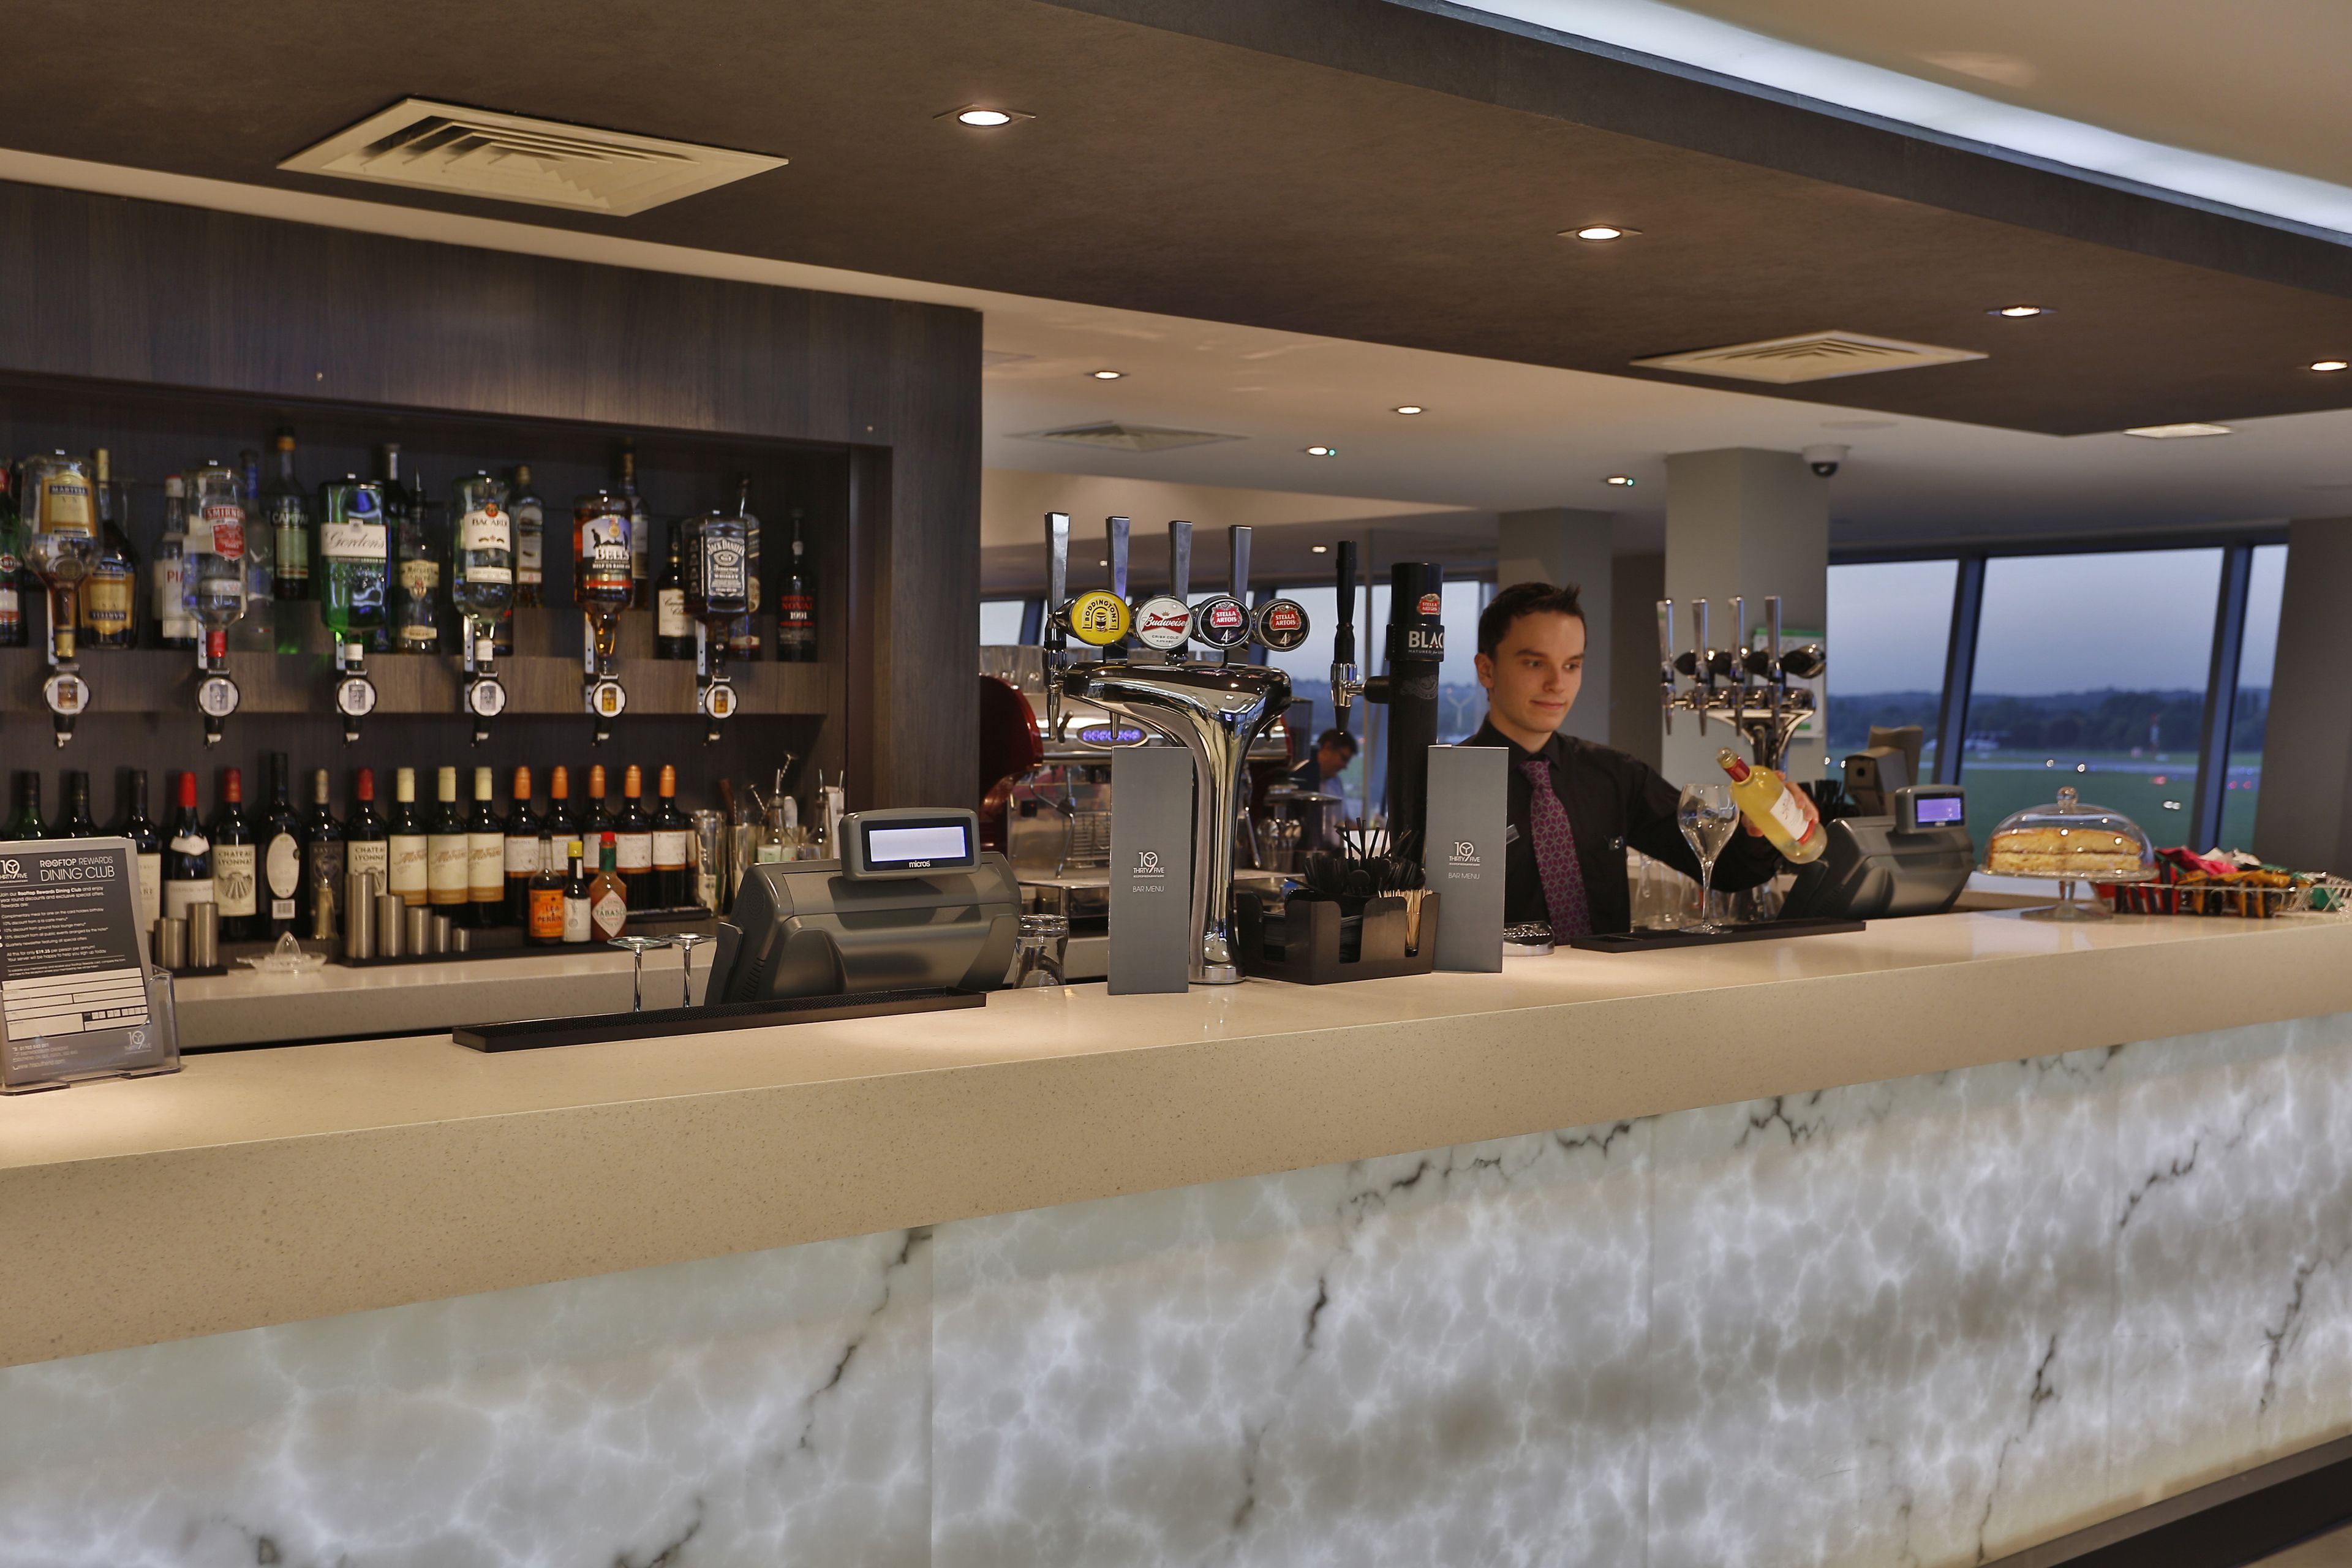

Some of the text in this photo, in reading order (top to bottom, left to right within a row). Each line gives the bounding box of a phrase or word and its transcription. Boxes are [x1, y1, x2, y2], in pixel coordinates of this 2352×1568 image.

[327, 531, 385, 548] Gordon's
[1085, 600, 1117, 623] BODDINGTONS
[1143, 616, 1189, 627] Budweiser
[1220, 629, 1230, 643] 4
[1280, 632, 1290, 646] 4
[1409, 631, 1443, 649] BLAC
[1455, 842, 1474, 862] 19
[40, 856, 113, 867] ROOFTOP REWARDS
[1139, 852, 1158, 873] 19
[40, 865, 115, 882] DINING CLUB
